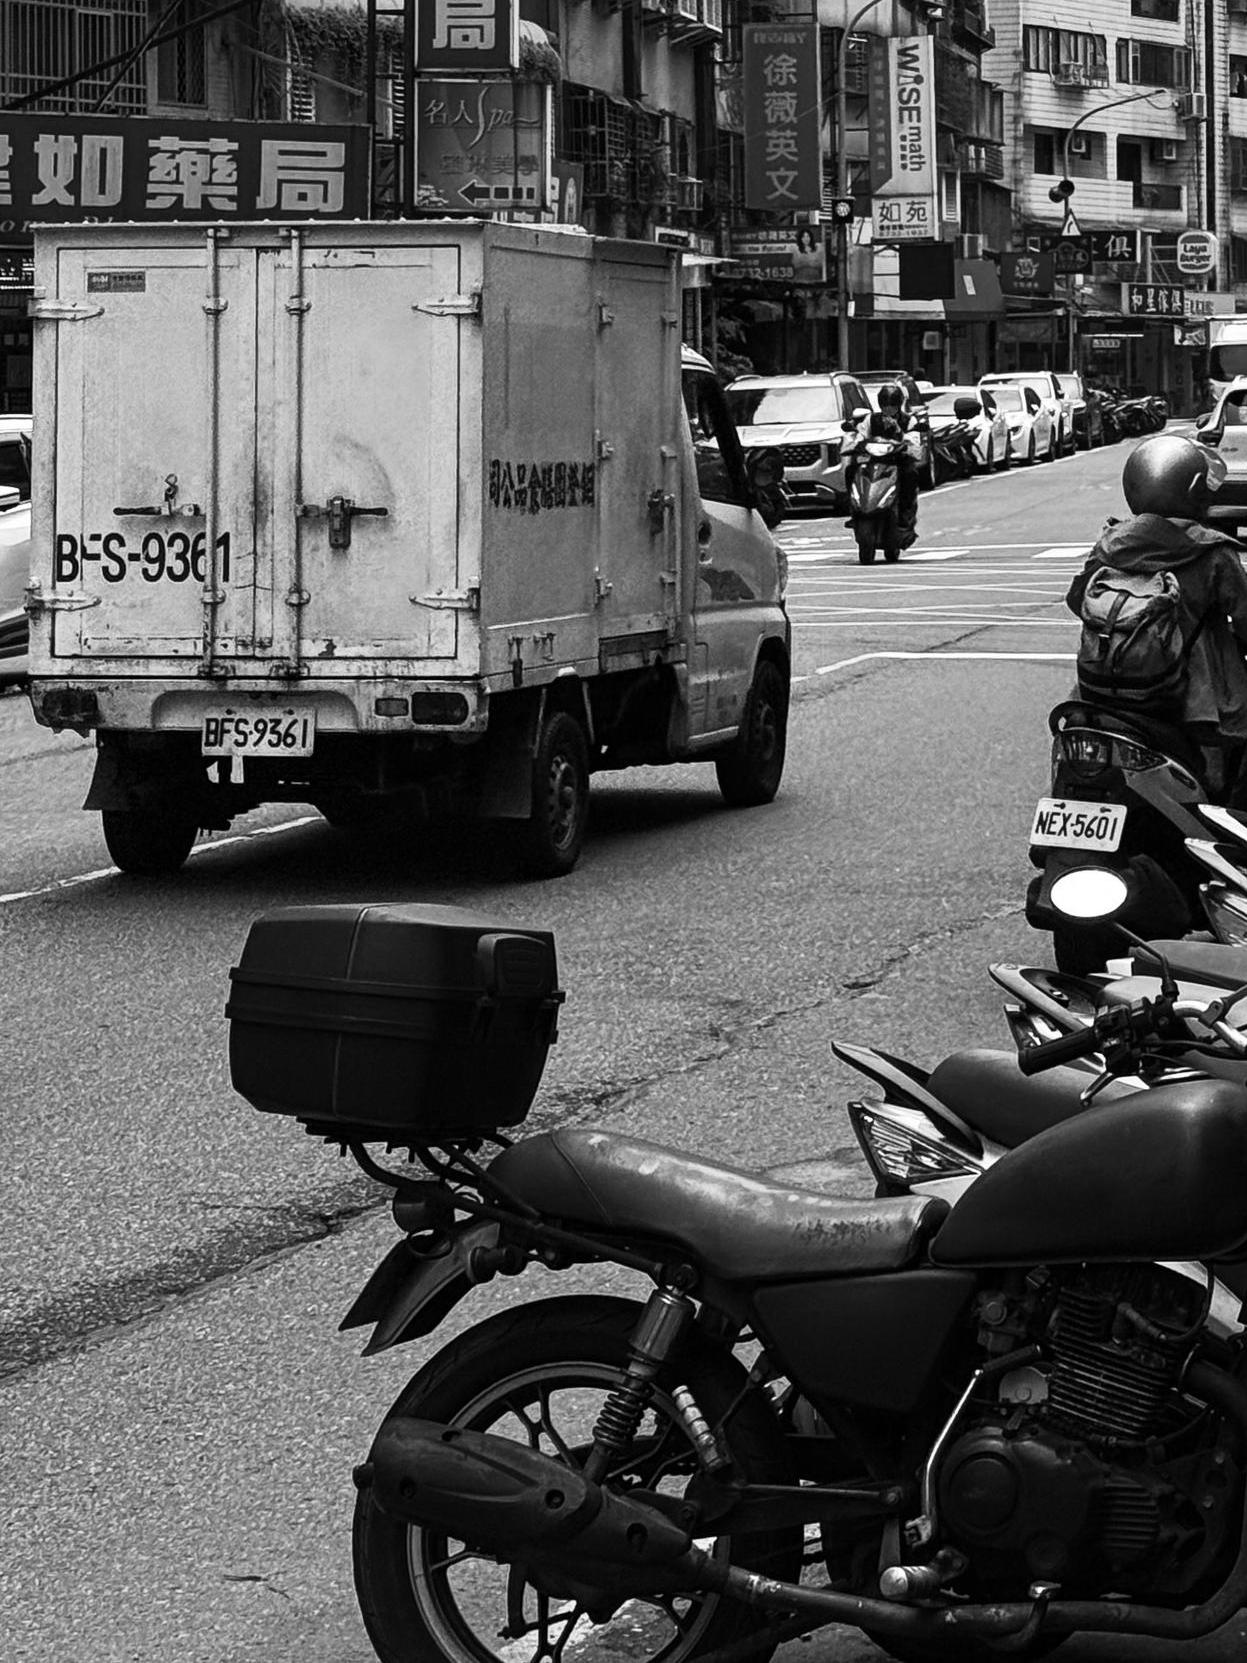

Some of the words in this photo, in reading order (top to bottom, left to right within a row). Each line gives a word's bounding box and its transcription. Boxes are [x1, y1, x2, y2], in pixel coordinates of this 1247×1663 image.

[763, 53, 799, 200] 徐薇英文
[908, 125, 927, 172] math
[879, 200, 928, 224] 如苑
[1183, 244, 1208, 255] Laya
[57, 532, 231, 583] BFS-9361
[1034, 811, 1119, 842] NEX-5601
